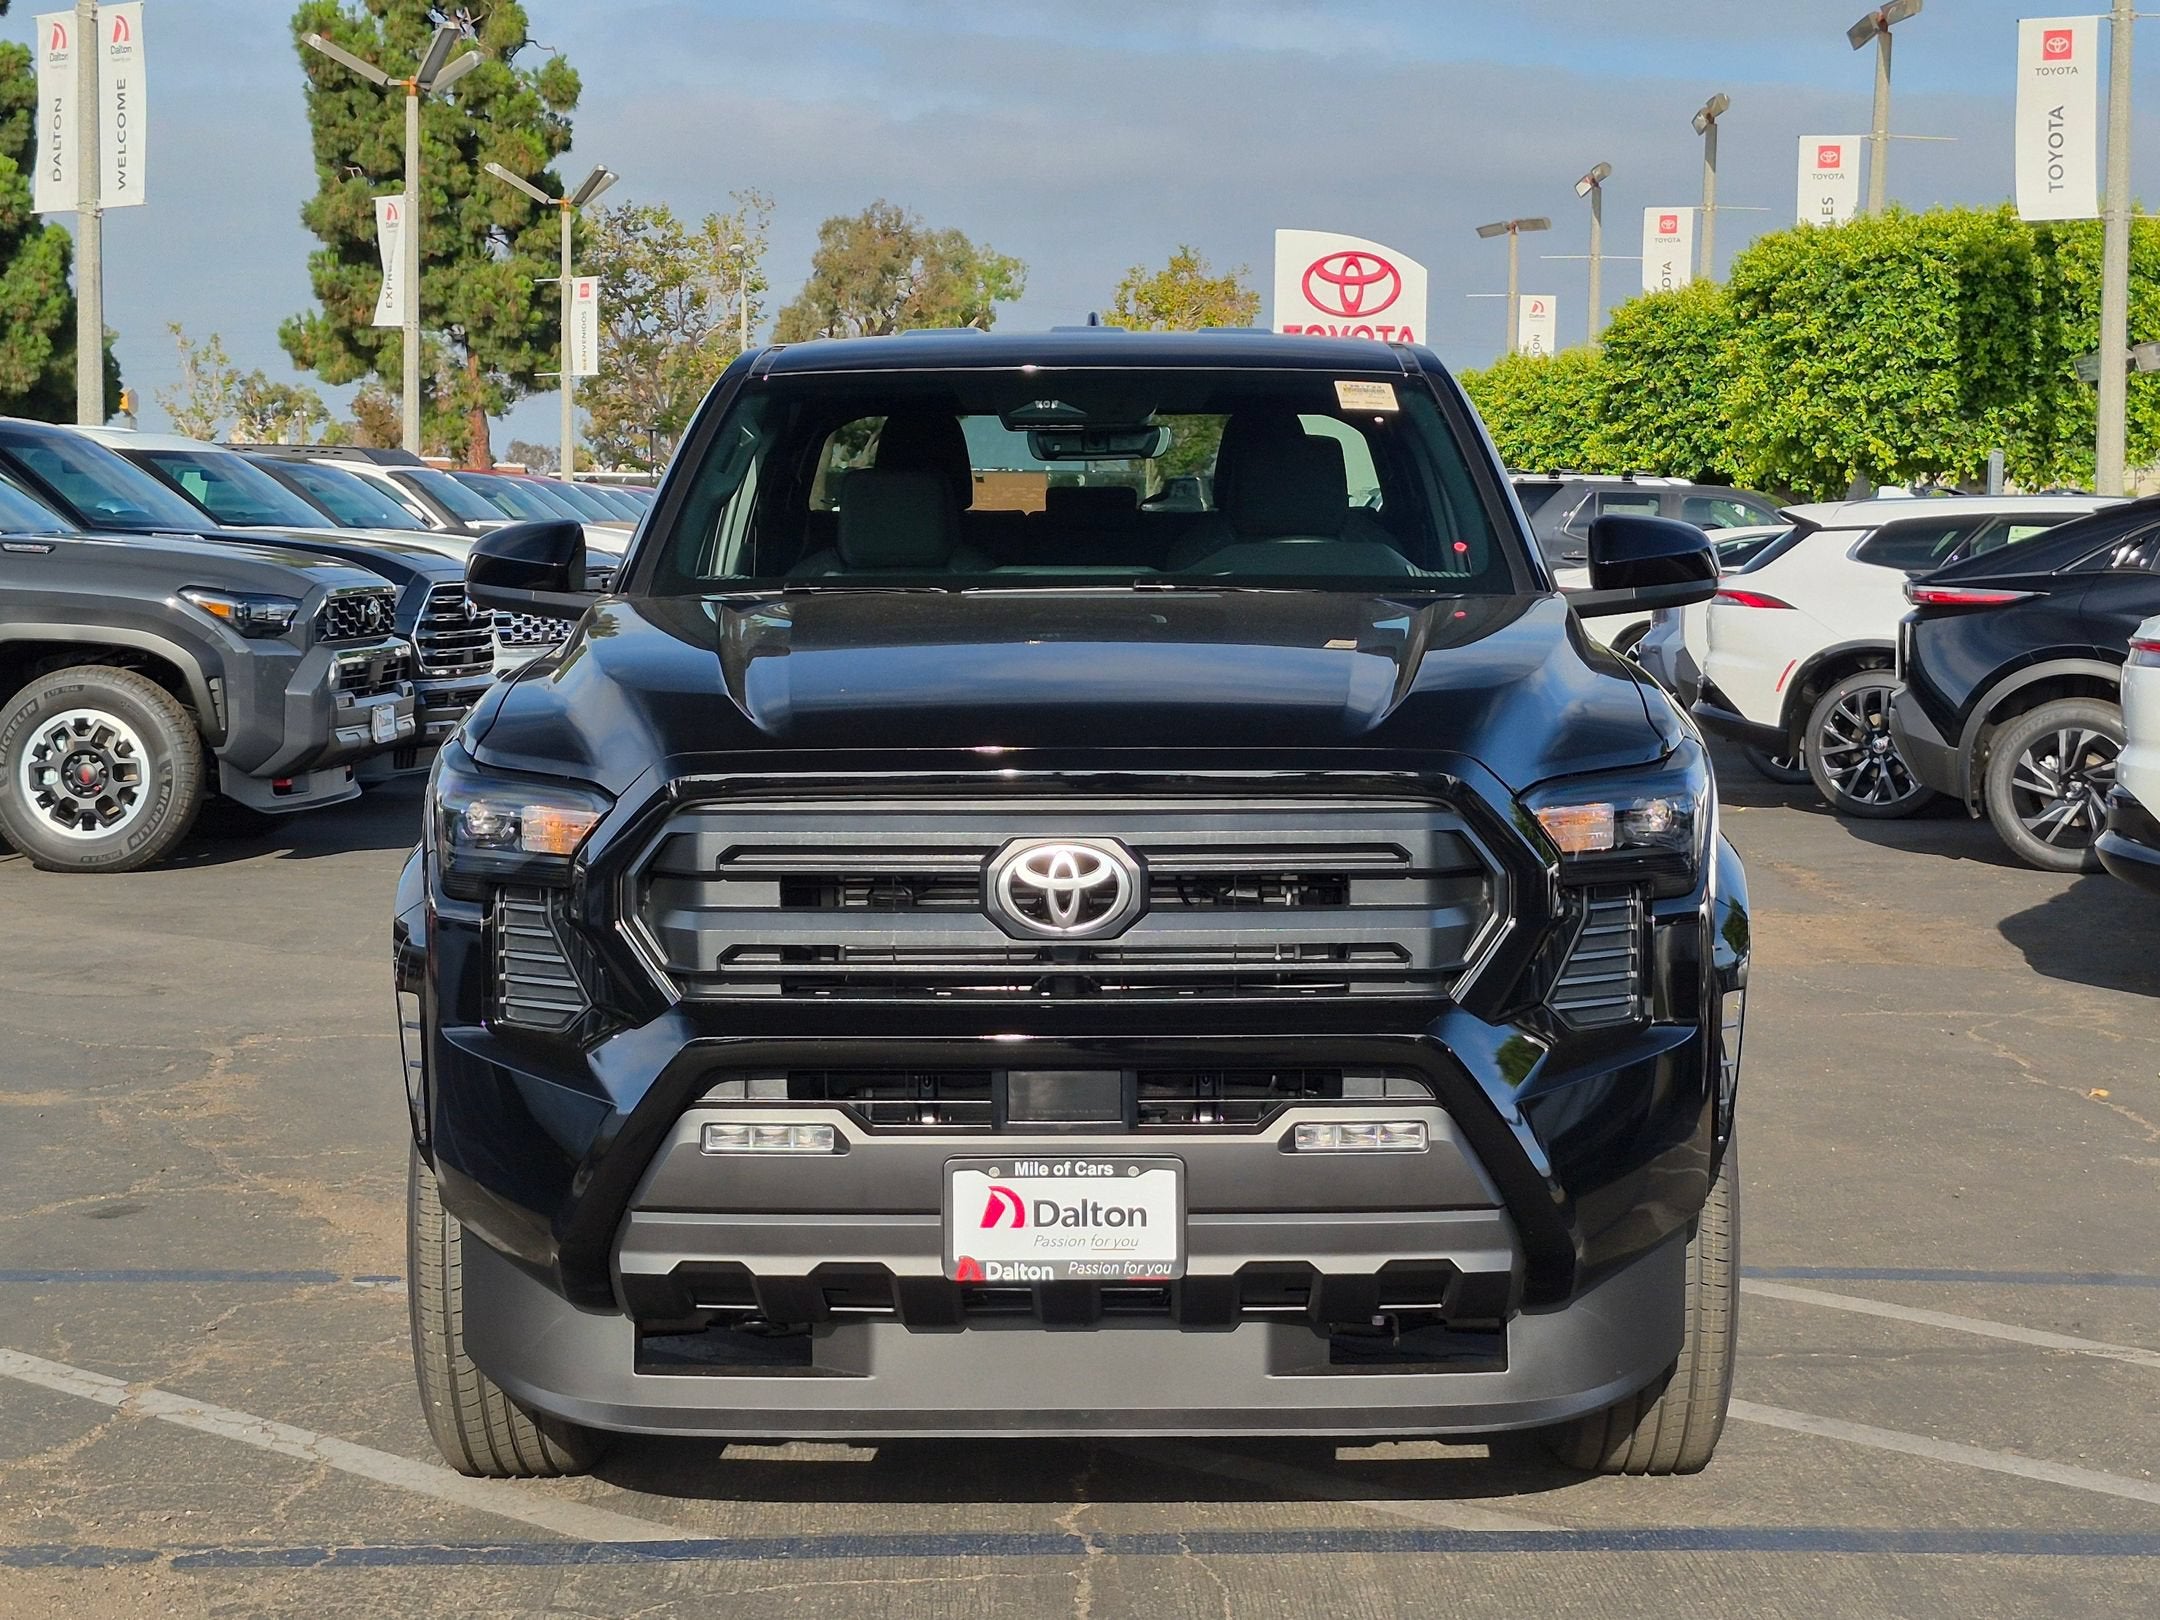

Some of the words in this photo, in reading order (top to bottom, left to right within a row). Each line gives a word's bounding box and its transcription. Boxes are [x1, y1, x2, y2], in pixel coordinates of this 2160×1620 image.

[110, 45, 132, 55] Dalton
[2036, 67, 2078, 76] TOYOTA
[53, 97, 62, 182] DALTON
[117, 78, 127, 190] WELCOME
[2048, 105, 2064, 193] TOYOTA
[1662, 261, 1671, 290] OTA
[0, 701, 37, 765] MICHELIN
[130, 785, 170, 847] MICHELIN
[1014, 1161, 1048, 1176] Mile
[1053, 1161, 1071, 1176] of
[1074, 1161, 1114, 1176] Cars
[1033, 1198, 1147, 1228] Dalton
[1033, 1234, 1086, 1248] Passion
[1090, 1233, 1111, 1248] for
[1113, 1236, 1139, 1249] you
[985, 1262, 1054, 1281] Dalton
[1068, 1261, 1120, 1275] Passion
[1122, 1261, 1145, 1275] for
[1146, 1263, 1172, 1277] you
